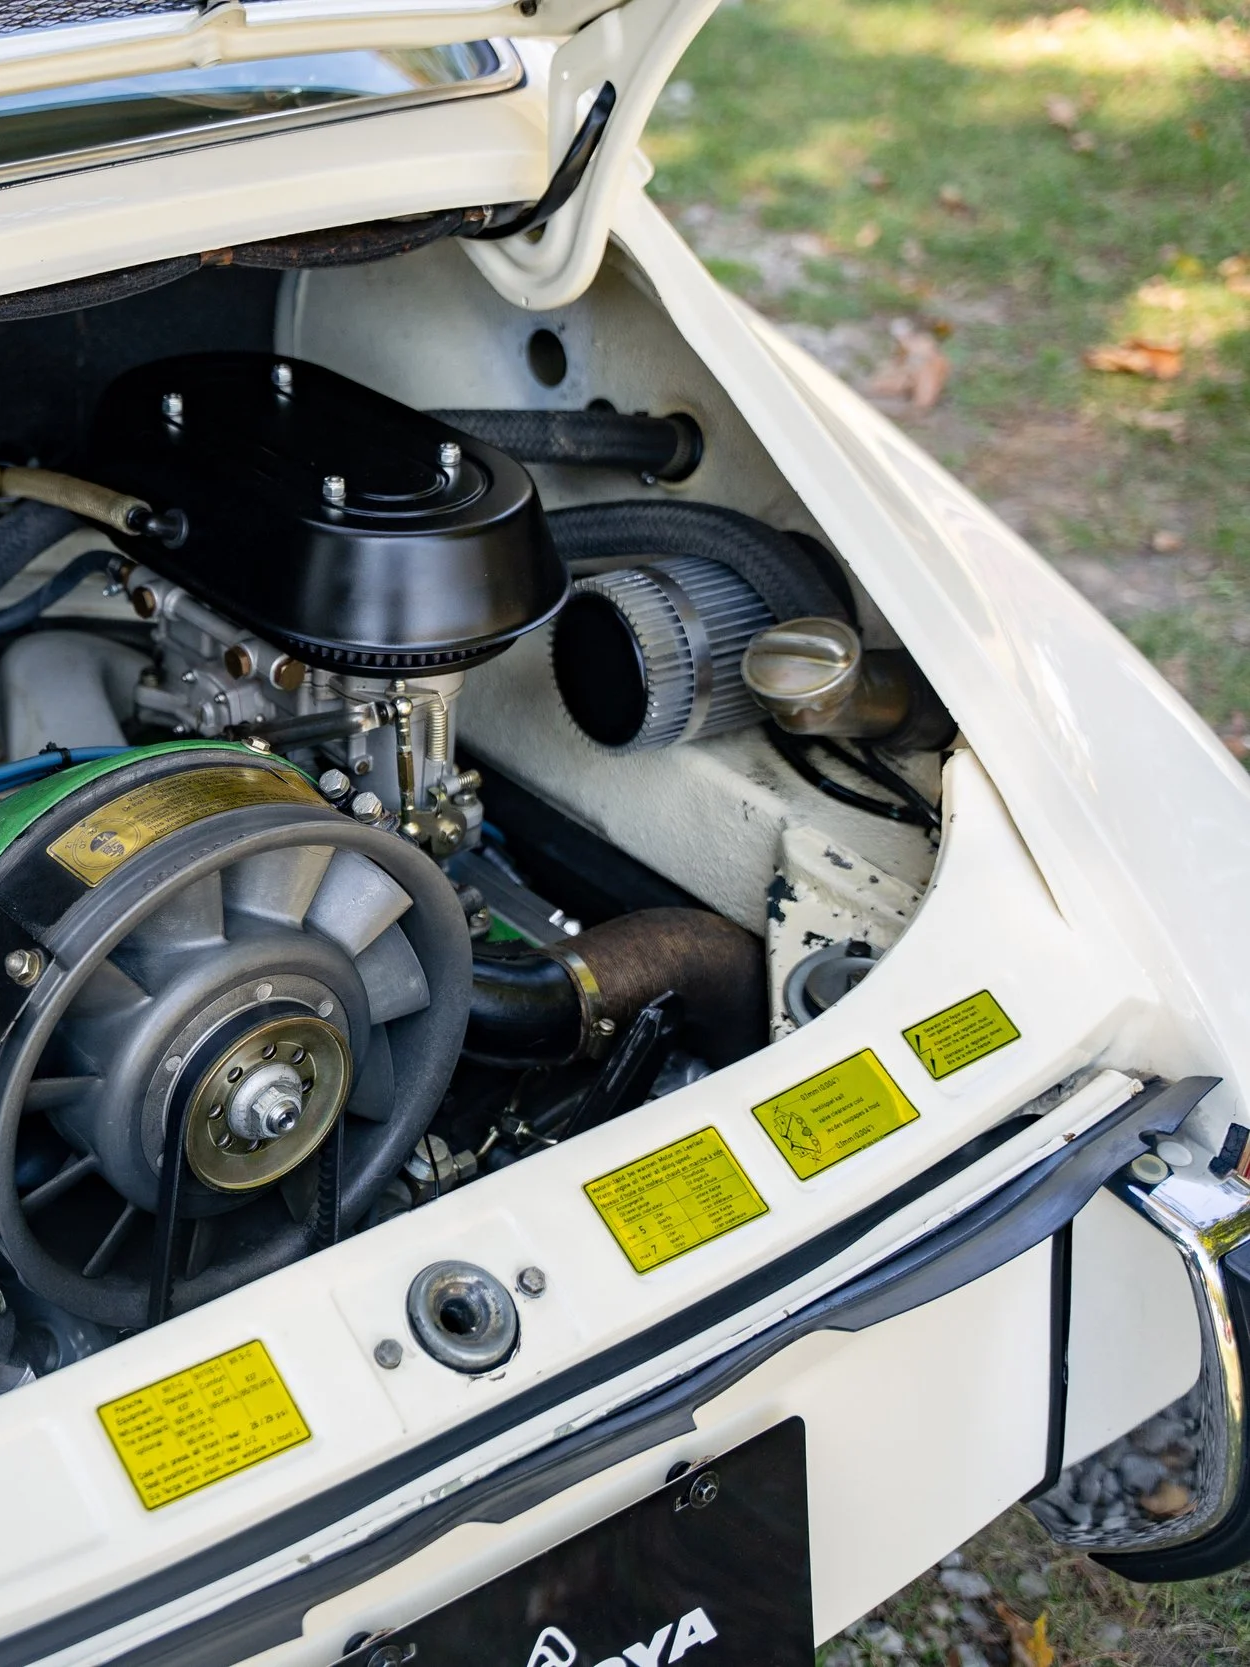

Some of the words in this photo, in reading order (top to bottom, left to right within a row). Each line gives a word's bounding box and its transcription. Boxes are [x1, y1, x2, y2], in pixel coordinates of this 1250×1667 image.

[829, 1102, 853, 1117] clearance
[852, 1096, 864, 1105] cold
[657, 1152, 674, 1162] Motor
[595, 1190, 613, 1201] Warm
[613, 1182, 631, 1194] engine
[639, 1171, 652, 1180] level
[599, 1197, 619, 1208] Niveau
[644, 1176, 663, 1188] moteur
[663, 1168, 680, 1179] chaud
[687, 1155, 708, 1168] marche
[593, 1607, 718, 1667] YA
